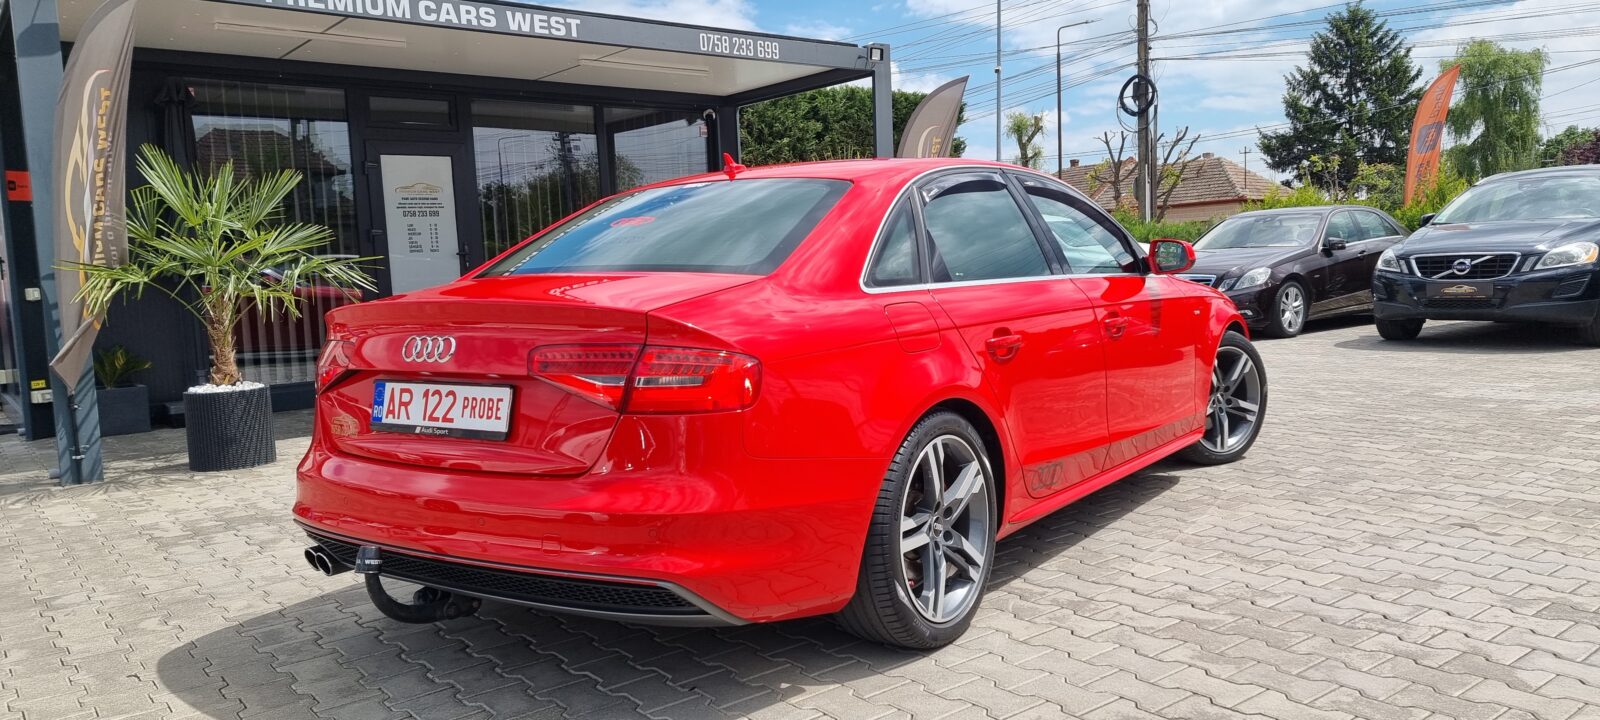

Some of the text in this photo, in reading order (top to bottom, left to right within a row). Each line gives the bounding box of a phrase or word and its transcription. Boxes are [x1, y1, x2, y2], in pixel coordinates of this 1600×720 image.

[418, 0, 497, 28] CARS
[506, 10, 581, 38] WEST
[699, 33, 780, 60] 0758 233 699
[96, 87, 111, 150] WEST
[373, 387, 504, 424] RO AR 122 PROBE
[433, 427, 449, 435] Sport
